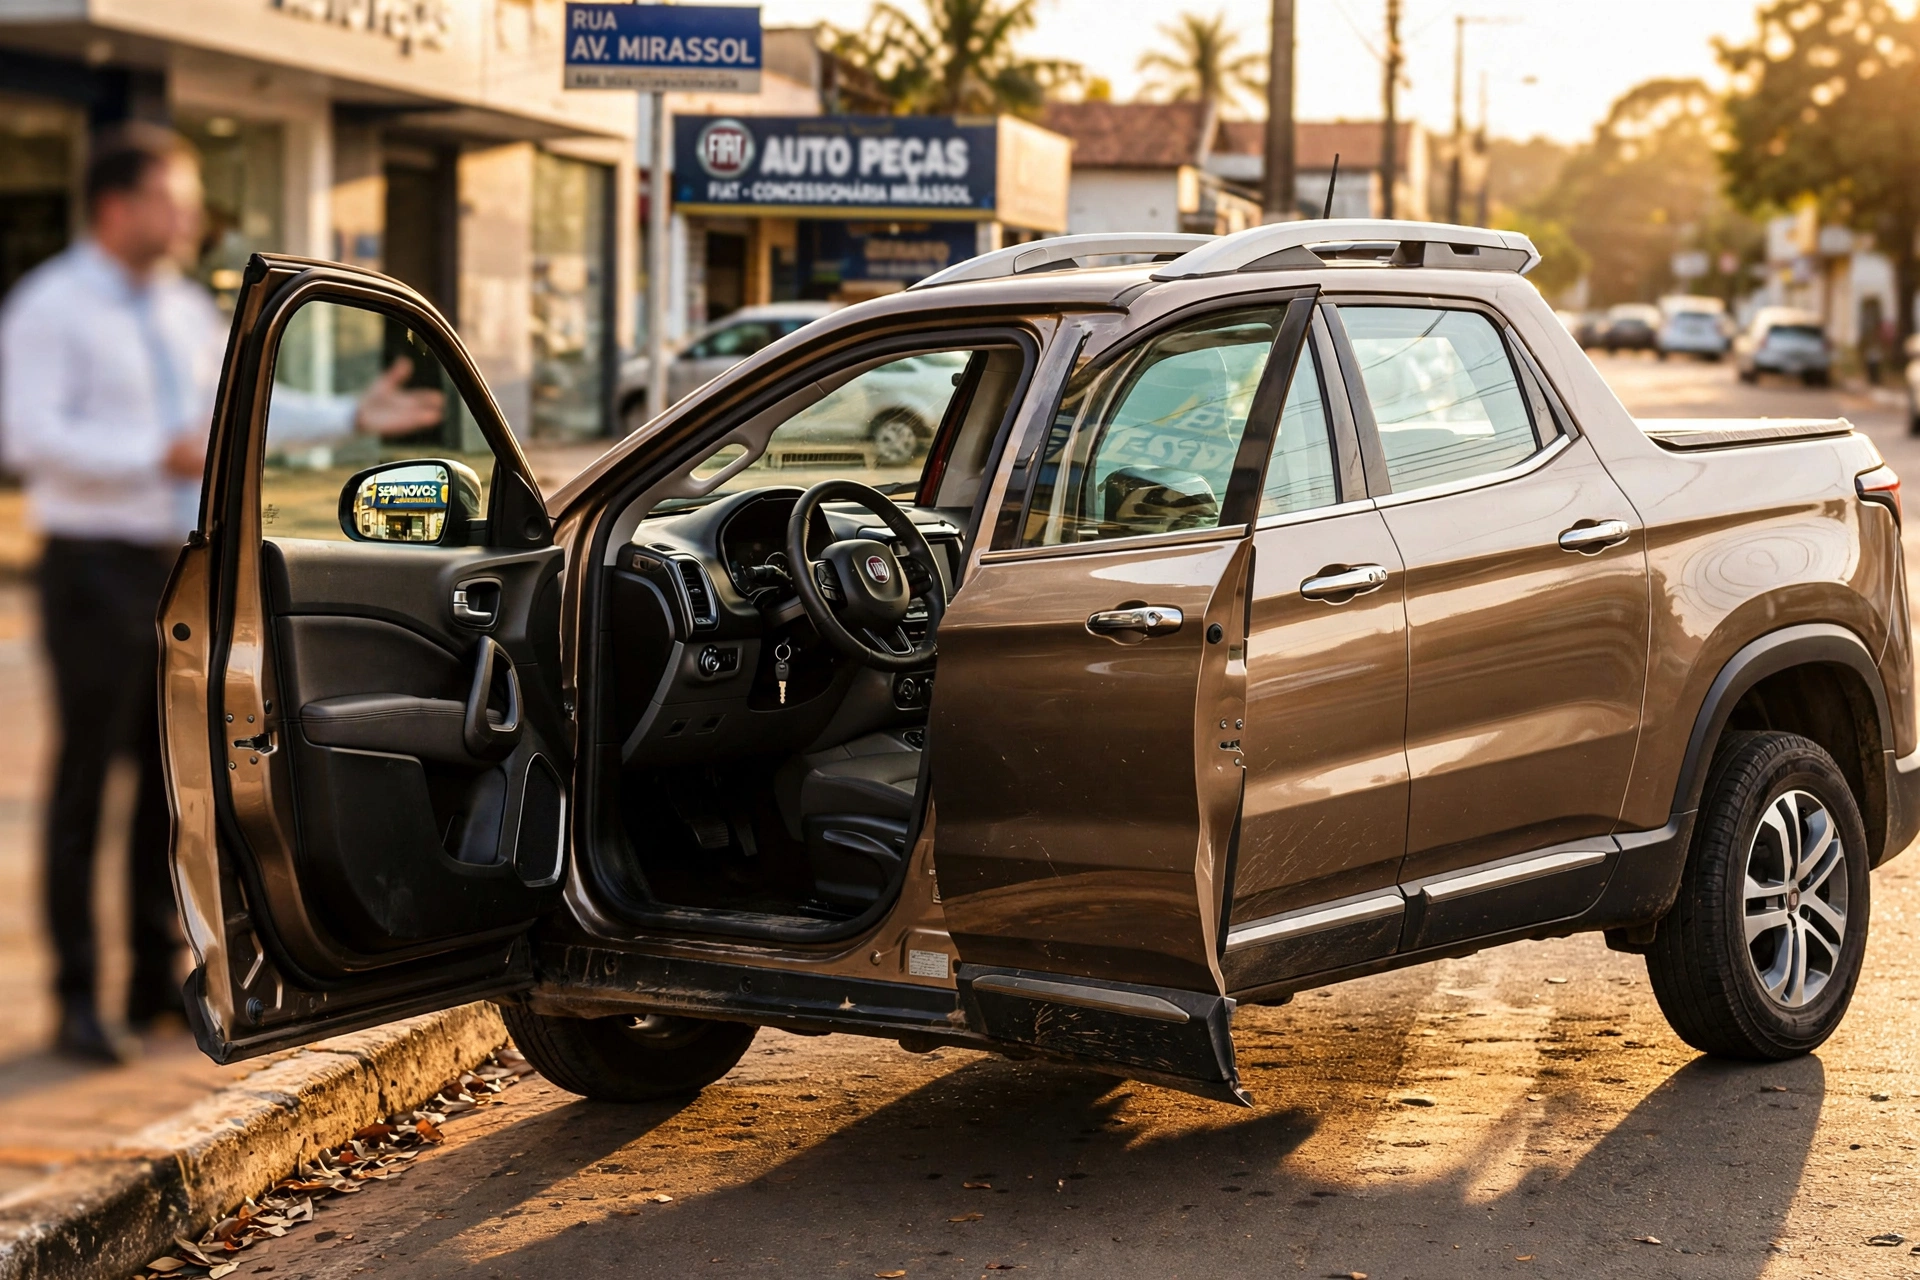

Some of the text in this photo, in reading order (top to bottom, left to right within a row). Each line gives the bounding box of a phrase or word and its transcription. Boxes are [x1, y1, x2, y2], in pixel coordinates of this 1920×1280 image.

[572, 9, 618, 31] RUA
[571, 35, 756, 64] AV. MIRASSOL
[760, 135, 969, 184] AUTO PEÇAS
